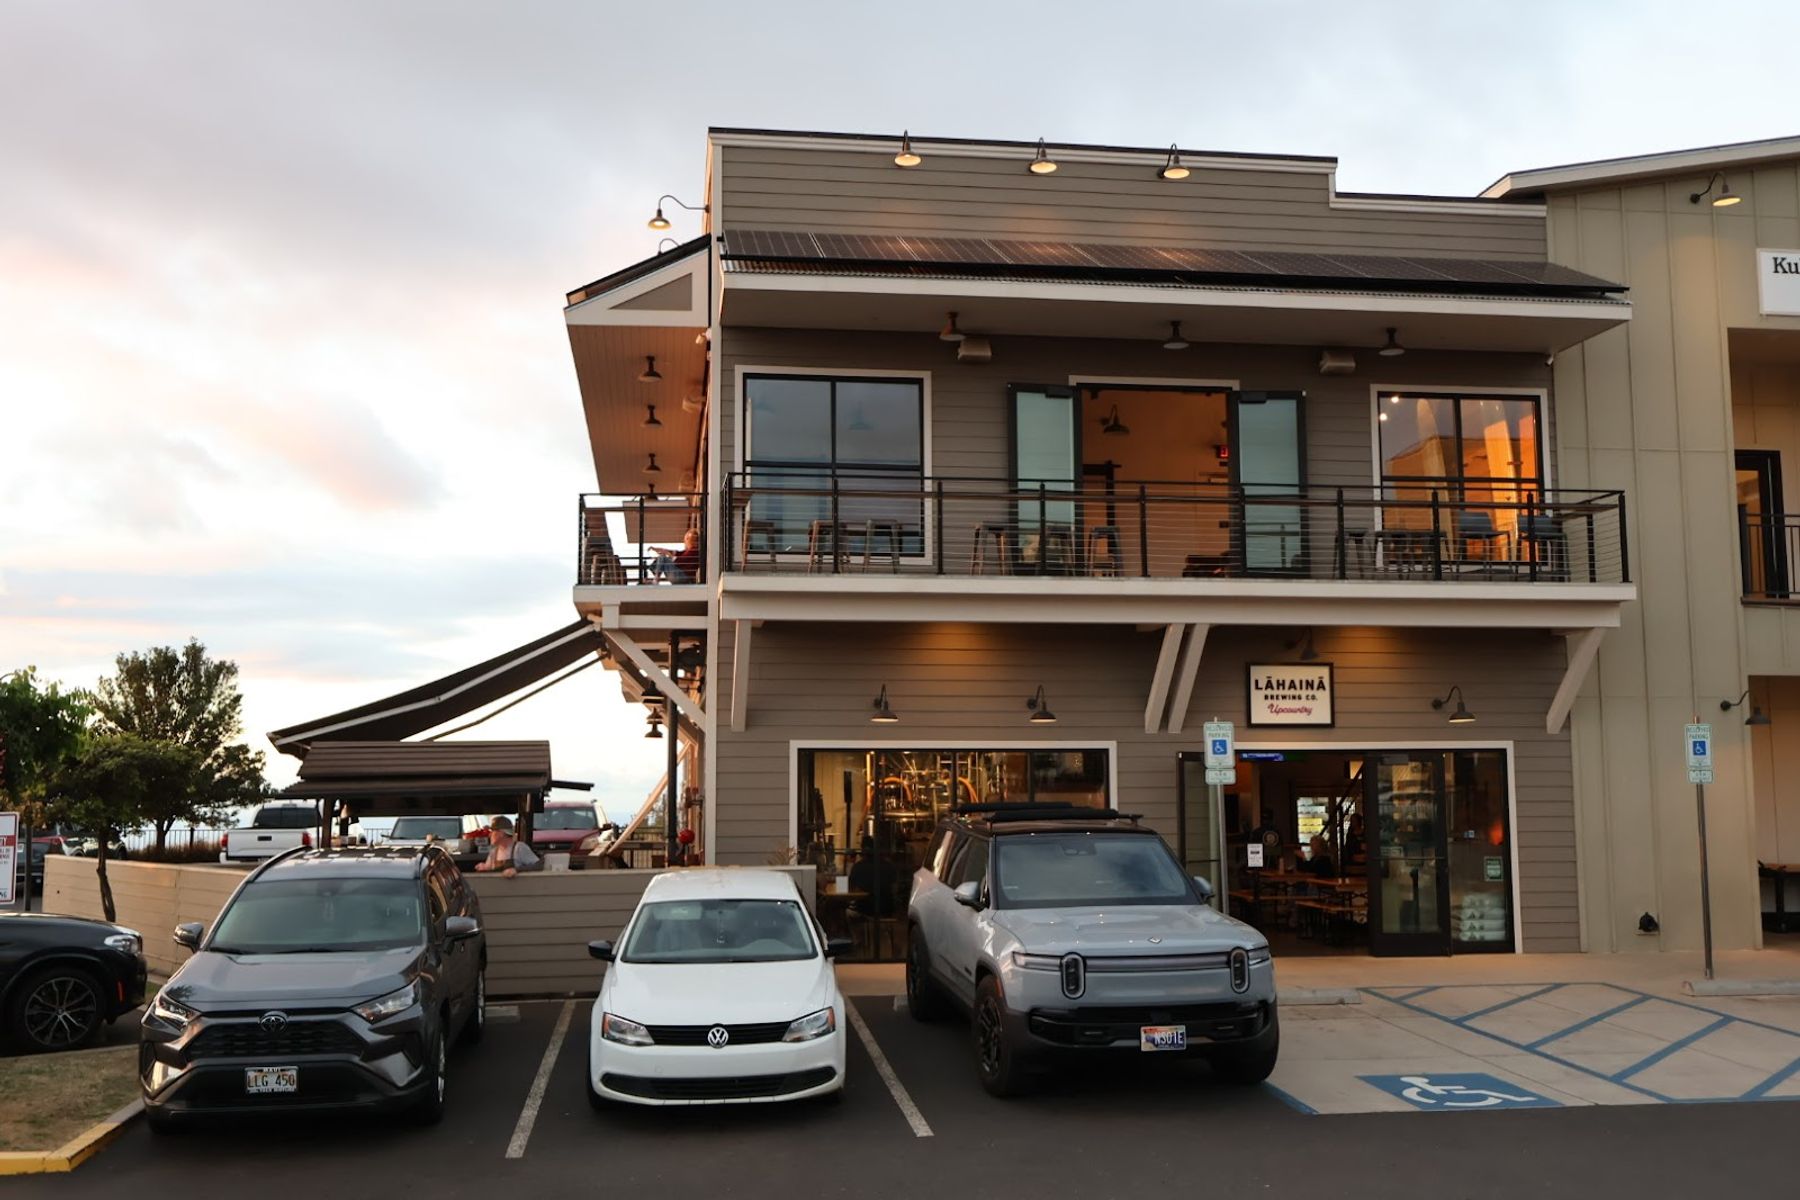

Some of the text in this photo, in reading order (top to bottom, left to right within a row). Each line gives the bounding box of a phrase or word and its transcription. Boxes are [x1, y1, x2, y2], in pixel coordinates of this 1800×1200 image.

[1254, 676, 1326, 691] LĀHAINĀ
[1267, 703, 1313, 716] Upcountry
[247, 1073, 295, 1088] LLG 450
